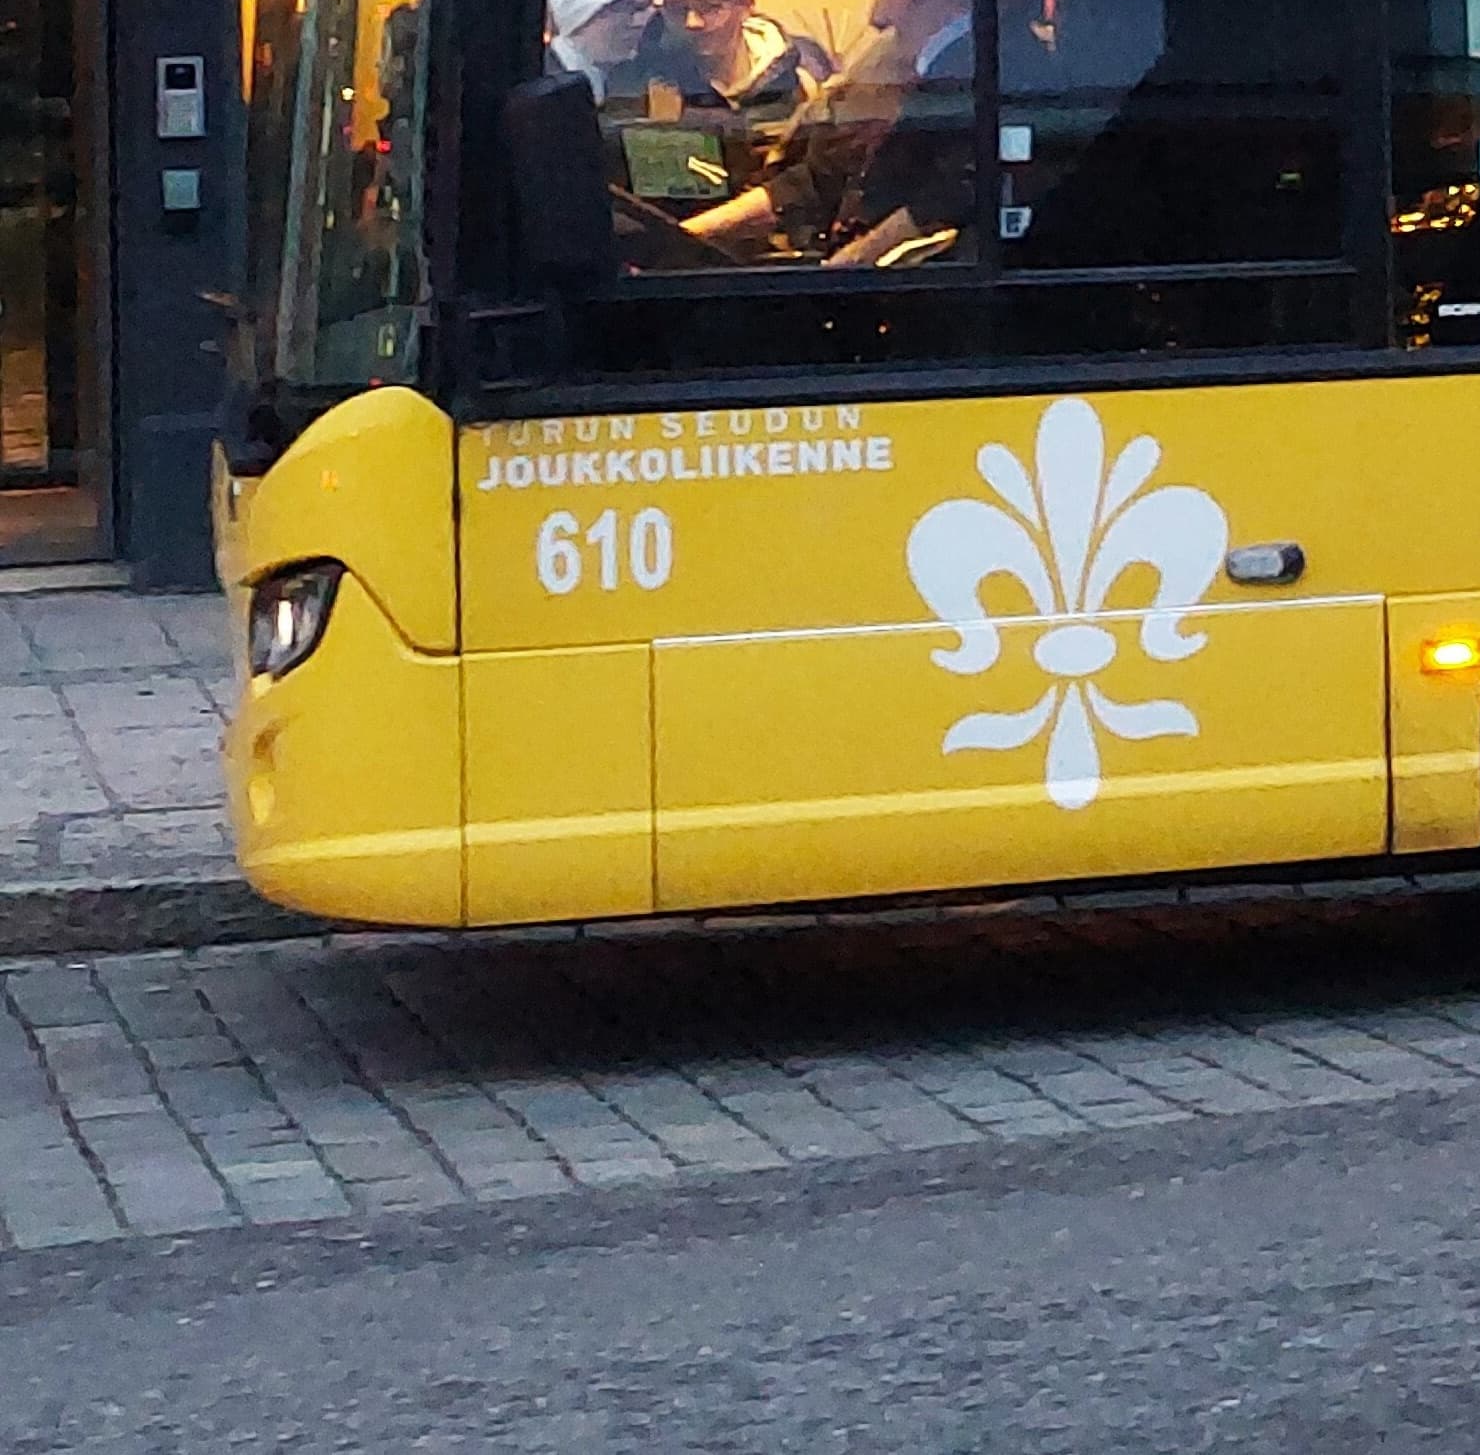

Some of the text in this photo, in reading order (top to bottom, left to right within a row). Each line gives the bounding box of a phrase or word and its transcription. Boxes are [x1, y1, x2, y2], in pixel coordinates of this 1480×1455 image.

[660, 403, 860, 439] SEUDUN
[476, 435, 894, 491] JOUKKOLIIKENNE
[535, 505, 673, 595] 610
